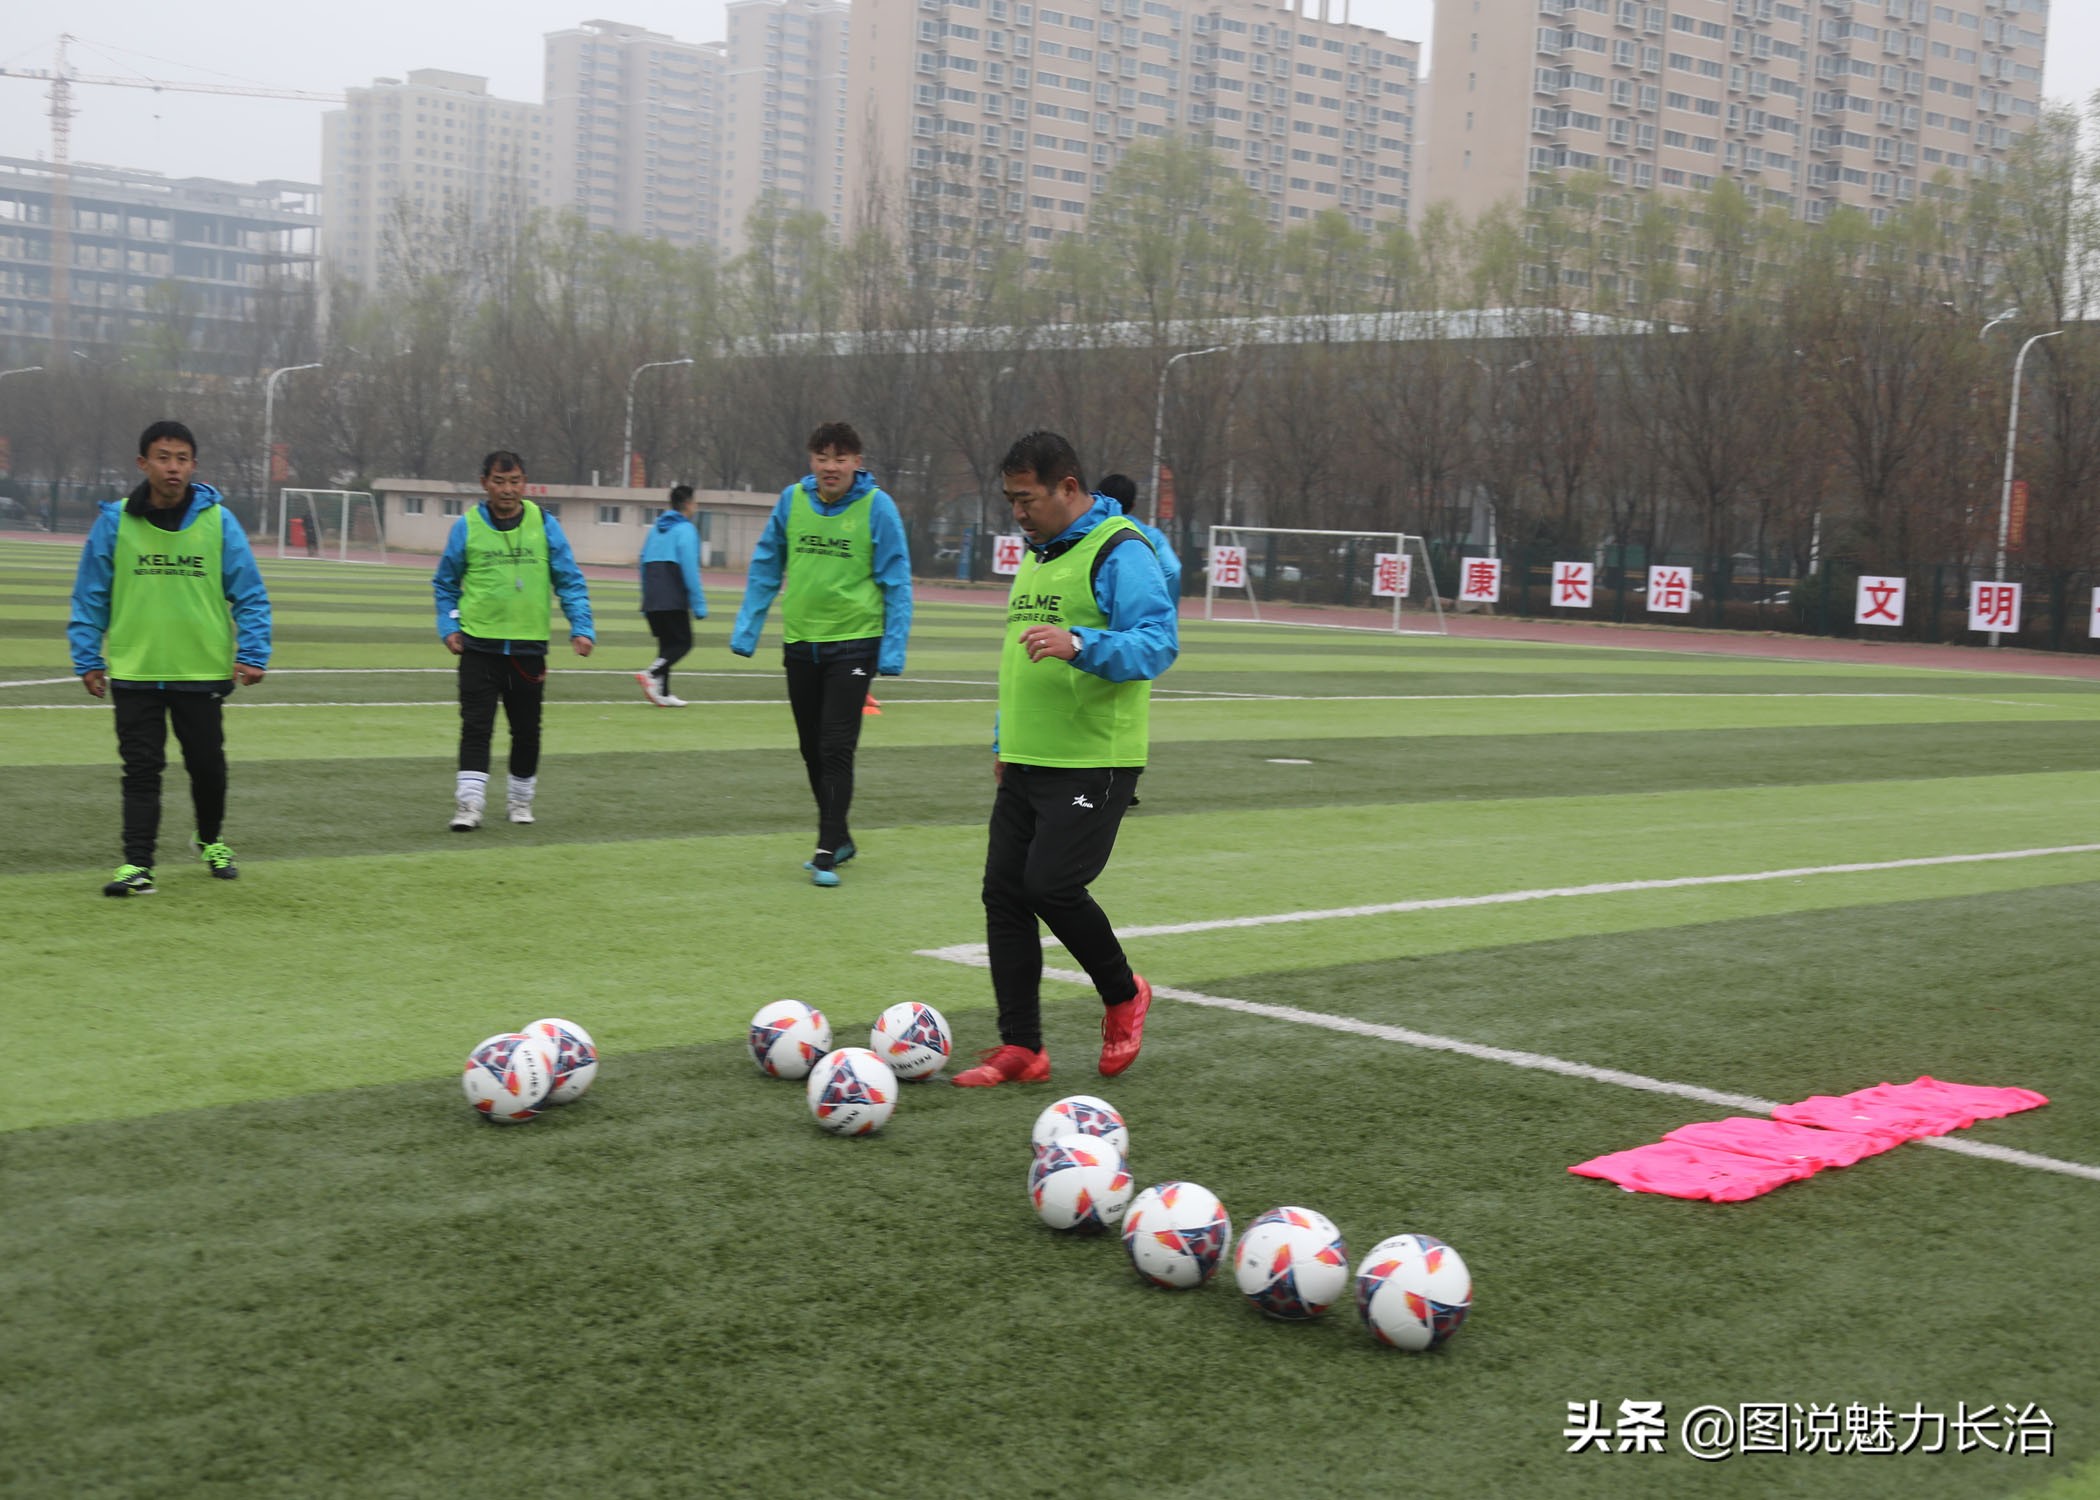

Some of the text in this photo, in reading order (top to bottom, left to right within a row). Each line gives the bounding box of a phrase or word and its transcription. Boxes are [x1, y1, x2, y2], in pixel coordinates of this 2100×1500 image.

[799, 534, 852, 551] KELME
[138, 553, 205, 569] KELME
[995, 540, 1022, 572] 体
[1215, 549, 1243, 583] 治
